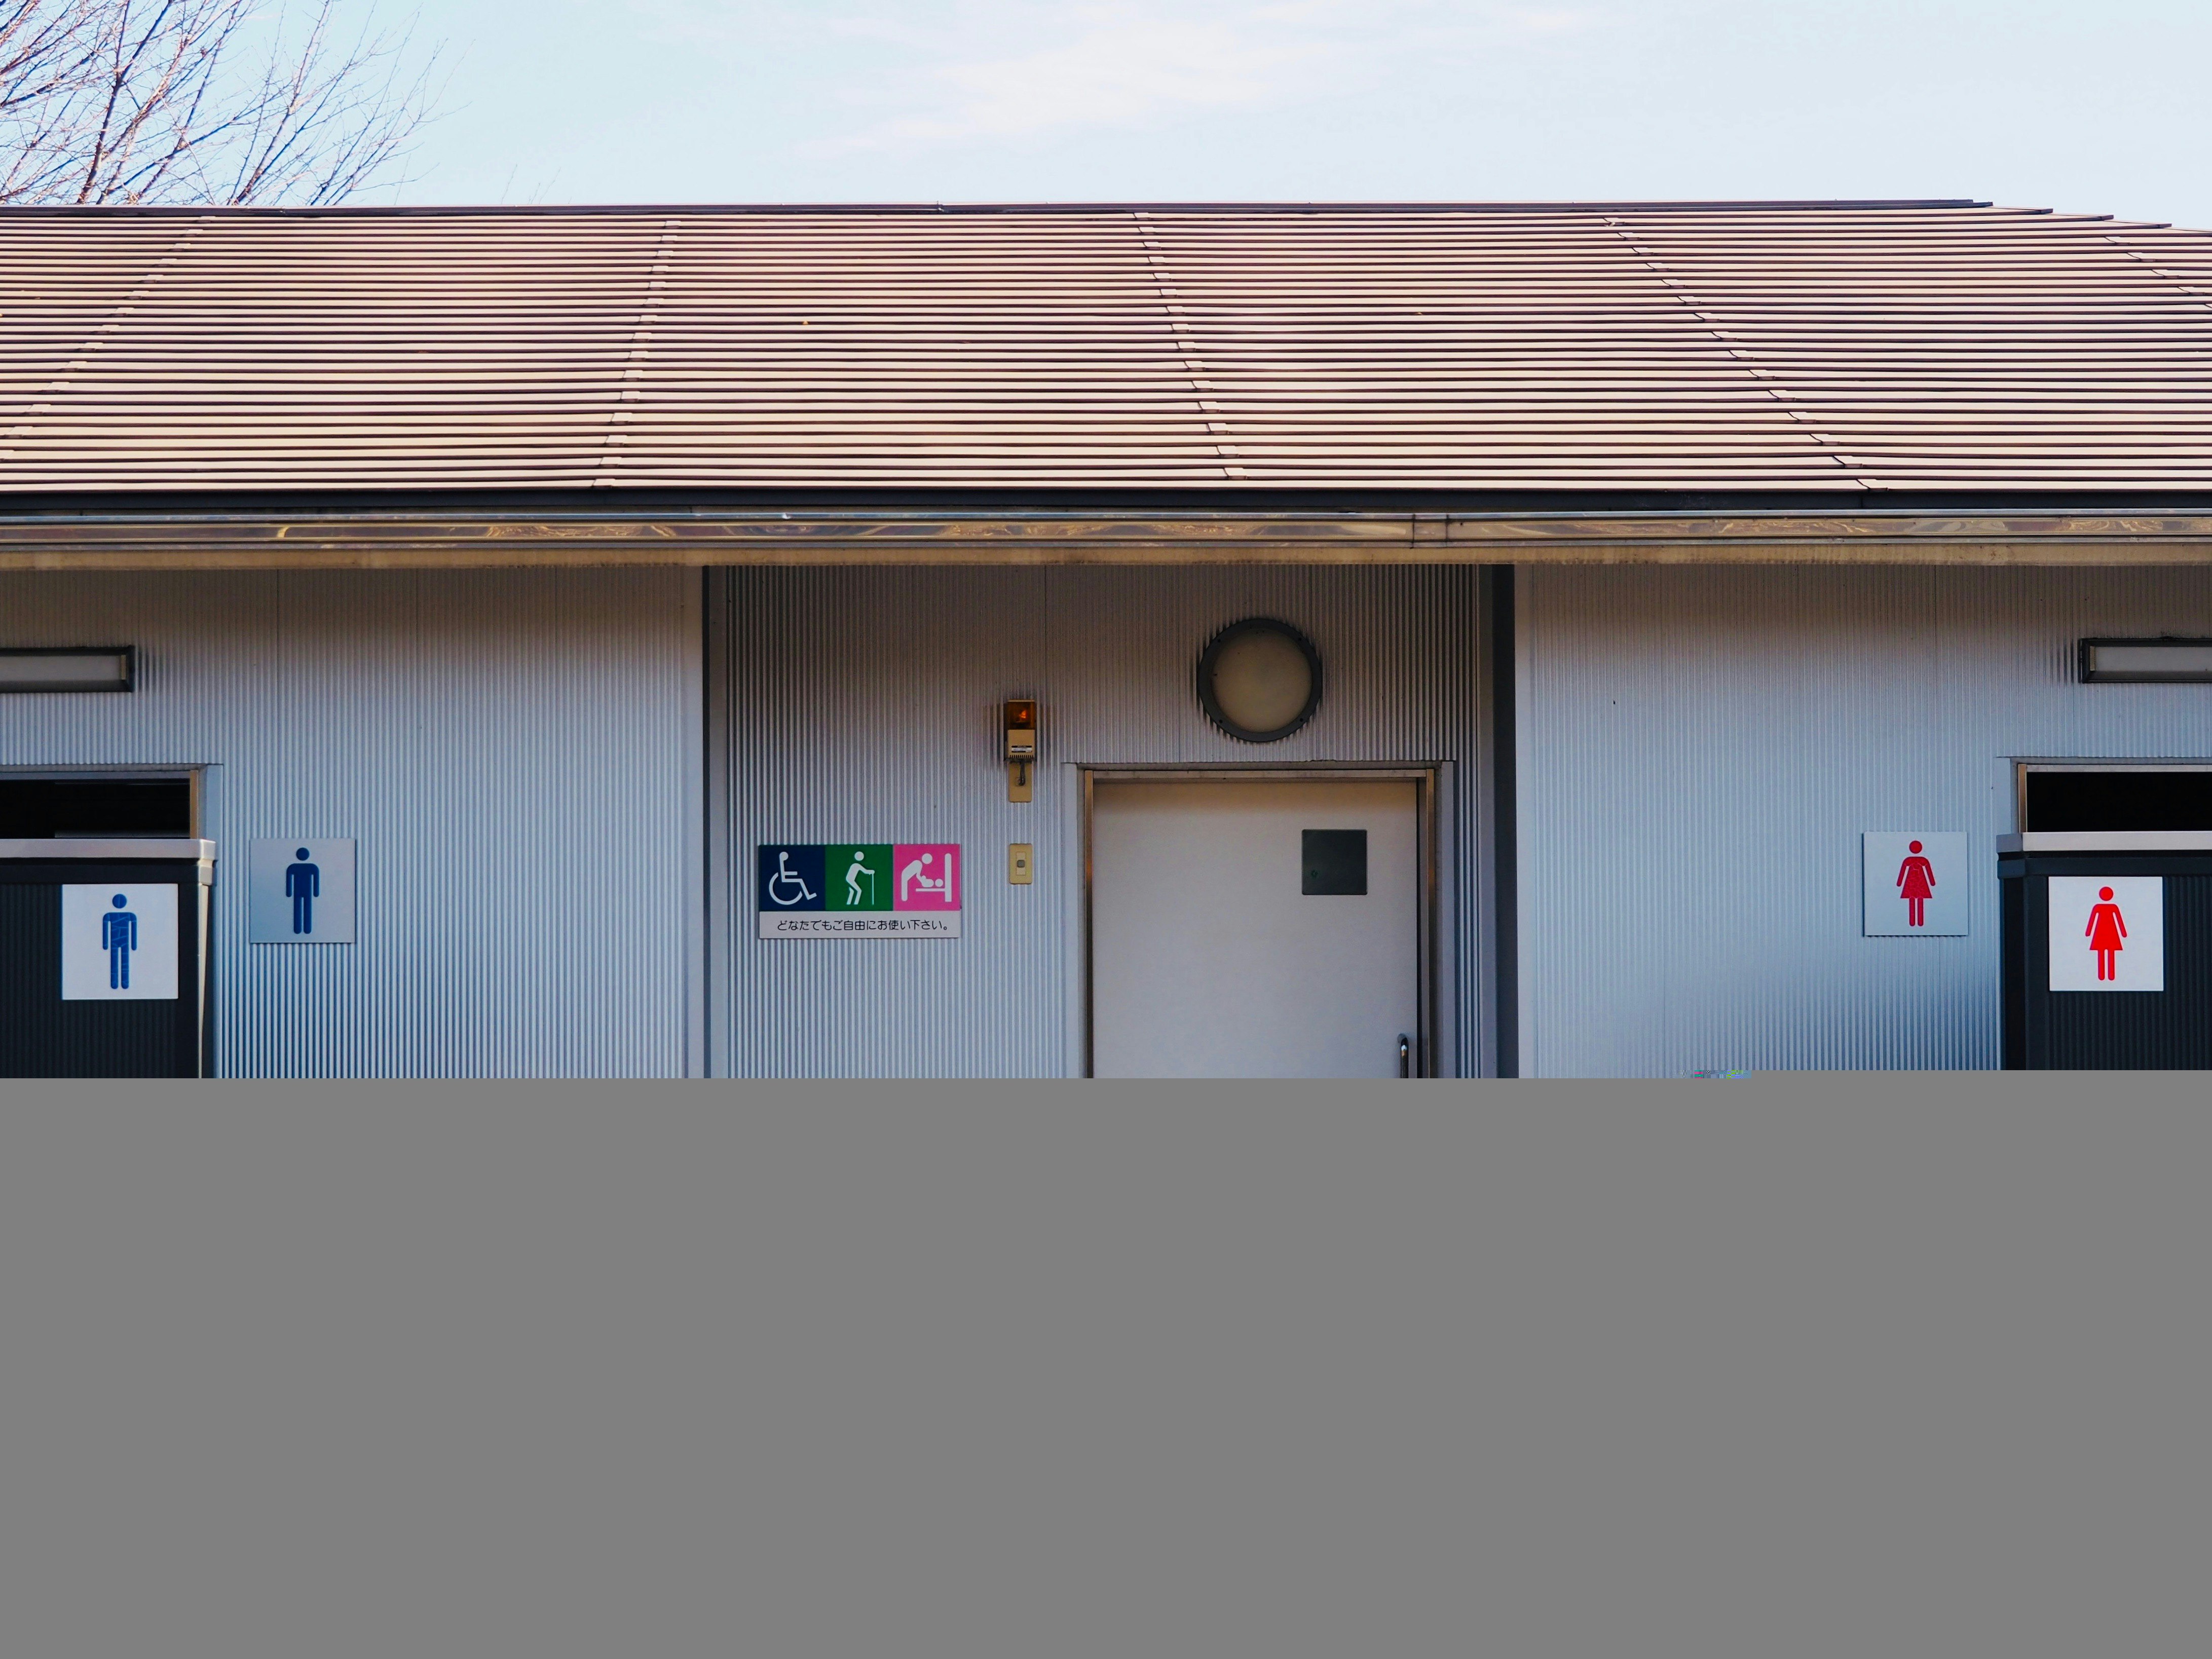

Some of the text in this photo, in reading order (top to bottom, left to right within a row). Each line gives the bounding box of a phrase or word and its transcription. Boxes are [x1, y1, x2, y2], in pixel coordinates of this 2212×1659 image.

[777, 919, 948, 930] どなたでもご自由にお使い下さい。
